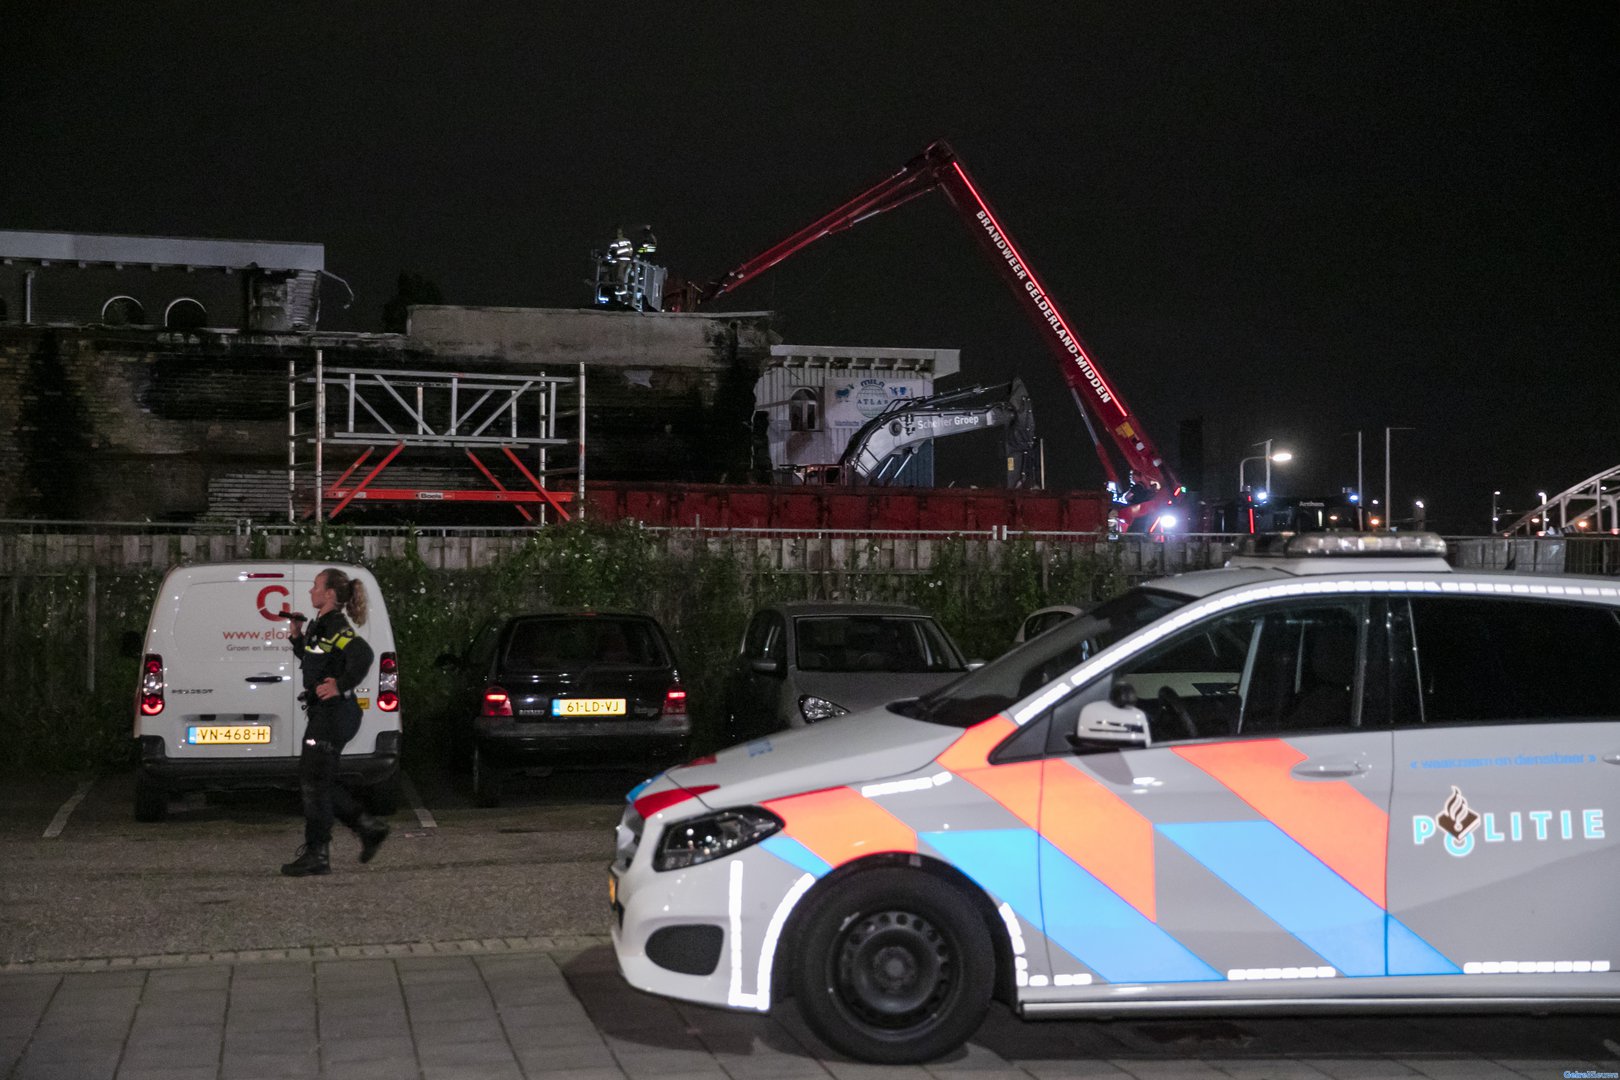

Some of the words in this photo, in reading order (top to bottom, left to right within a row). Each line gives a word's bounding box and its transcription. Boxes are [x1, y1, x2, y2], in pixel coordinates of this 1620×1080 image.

[976, 209, 1027, 280] BRANDWEER
[1025, 280, 1111, 404] GELDERLAND-MIDDEN
[953, 415, 979, 426] Groep
[226, 644, 250, 652] Groen
[566, 701, 619, 713] 61-LD-VJ
[198, 728, 267, 741] VN-468-H
[1494, 757, 1511, 767] en
[1413, 808, 1605, 857] POLITIE
